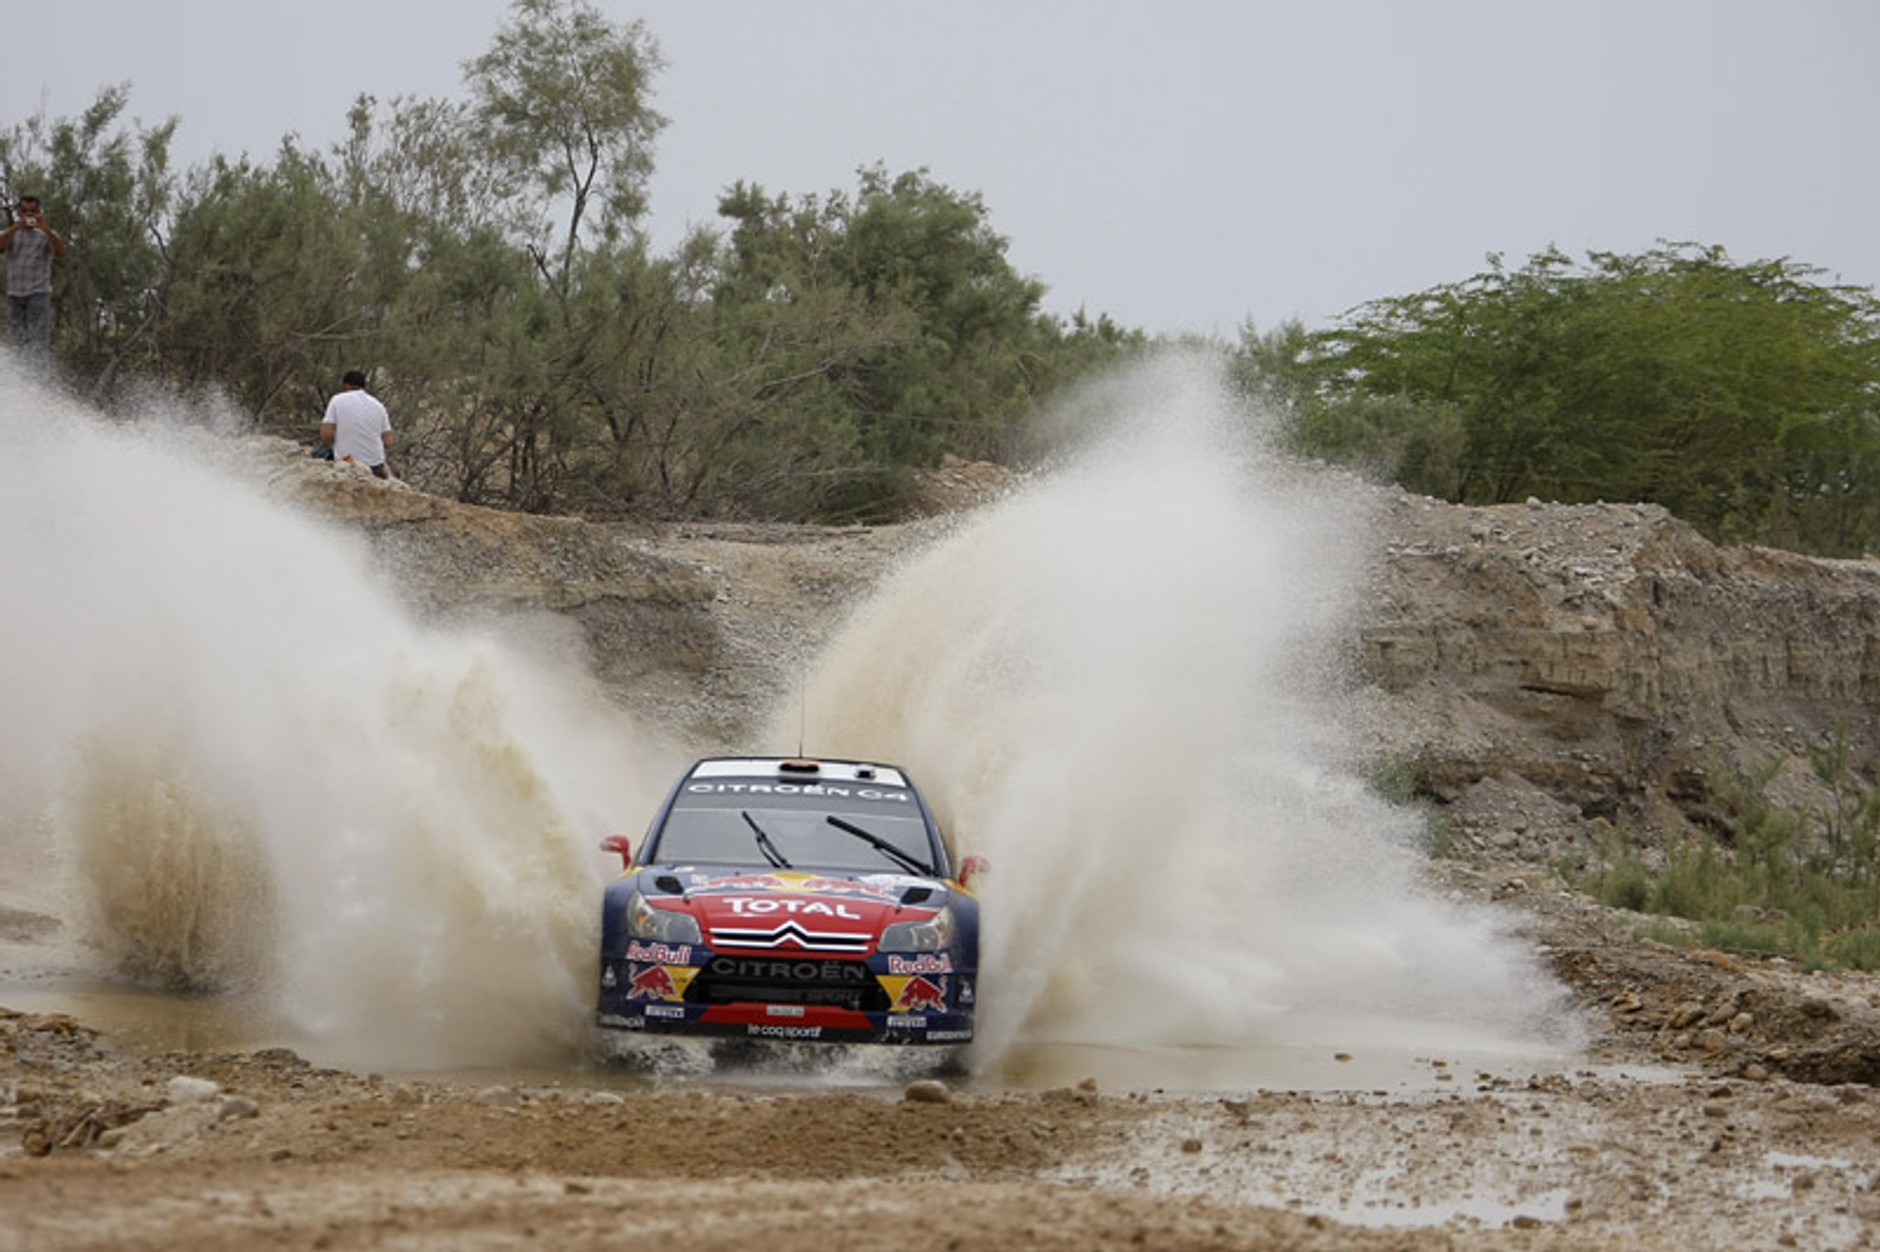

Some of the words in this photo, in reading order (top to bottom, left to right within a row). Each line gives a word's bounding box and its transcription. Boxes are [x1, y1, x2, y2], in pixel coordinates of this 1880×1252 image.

[688, 784, 850, 796] CITROËN
[857, 788, 908, 801] C4
[722, 898, 861, 920] TOTAL
[656, 944, 692, 966] Bull
[888, 953, 924, 974] Red
[711, 957, 865, 980] CITROËN
[748, 1022, 761, 1036] le
[761, 1026, 785, 1038] coq
[785, 1025, 823, 1039] sportif
